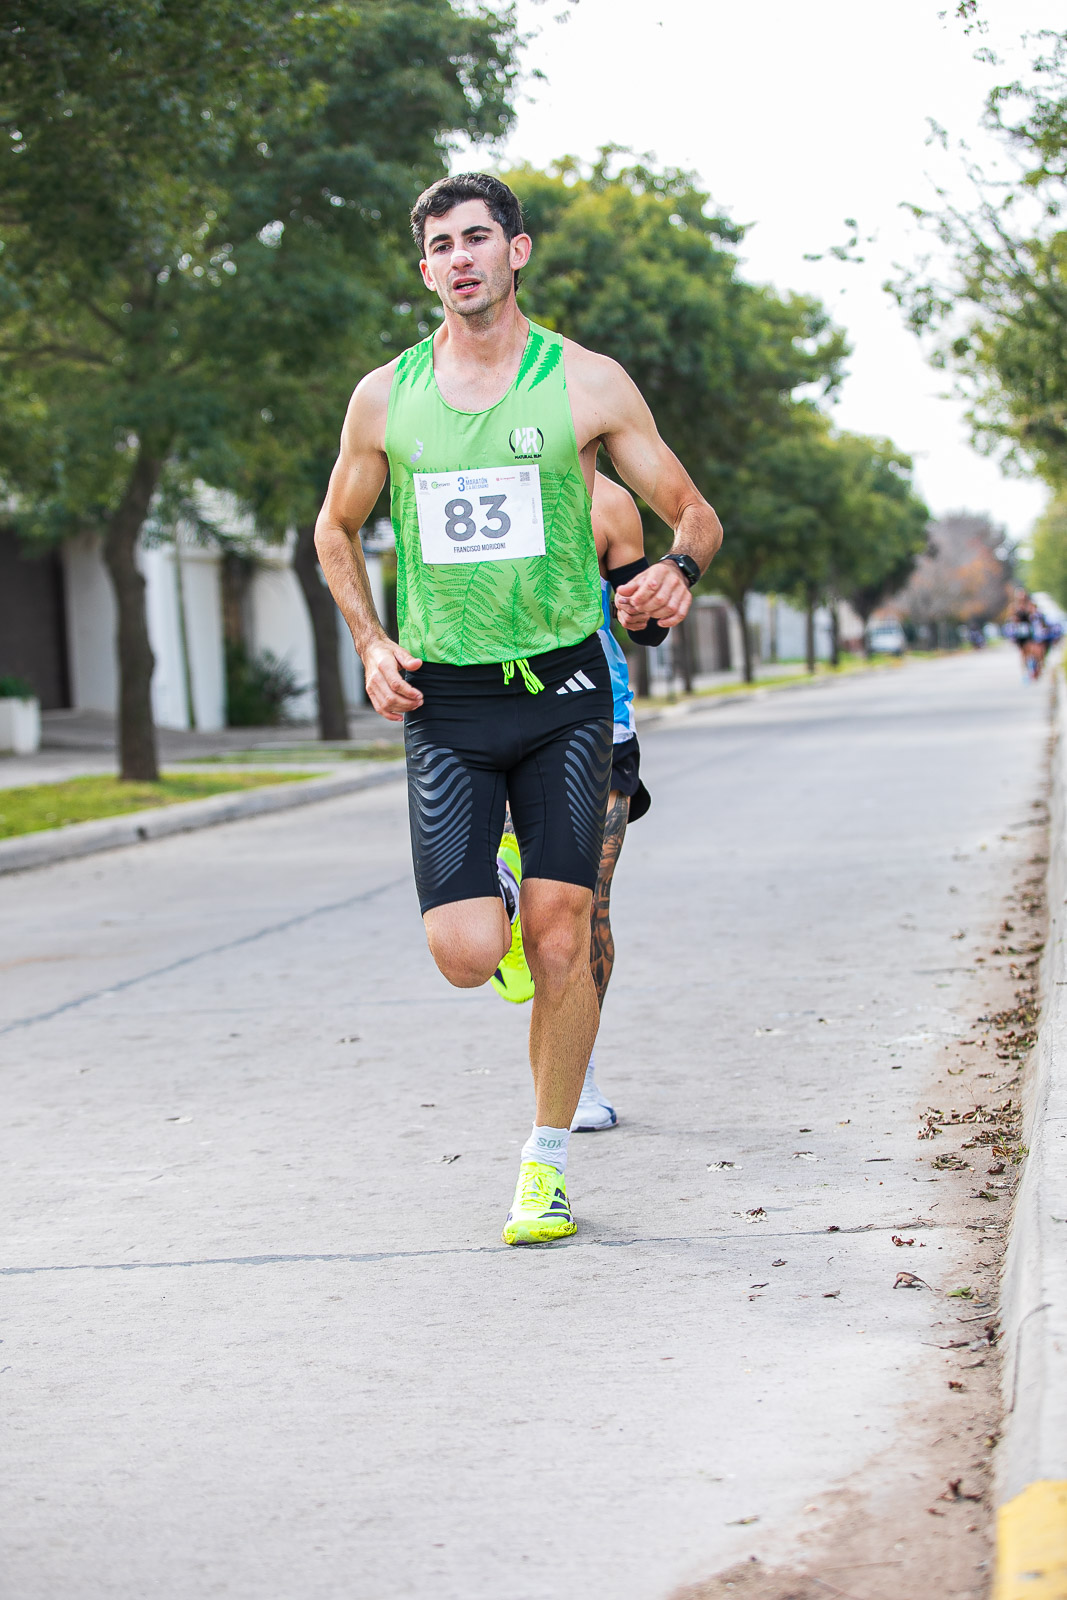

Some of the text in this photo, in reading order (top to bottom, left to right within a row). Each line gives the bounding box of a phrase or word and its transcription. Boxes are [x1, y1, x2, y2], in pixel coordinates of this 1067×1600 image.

[444, 494, 511, 542] 83
[453, 545, 480, 553] FRANCISCO
[537, 1137, 563, 1148] SOX
